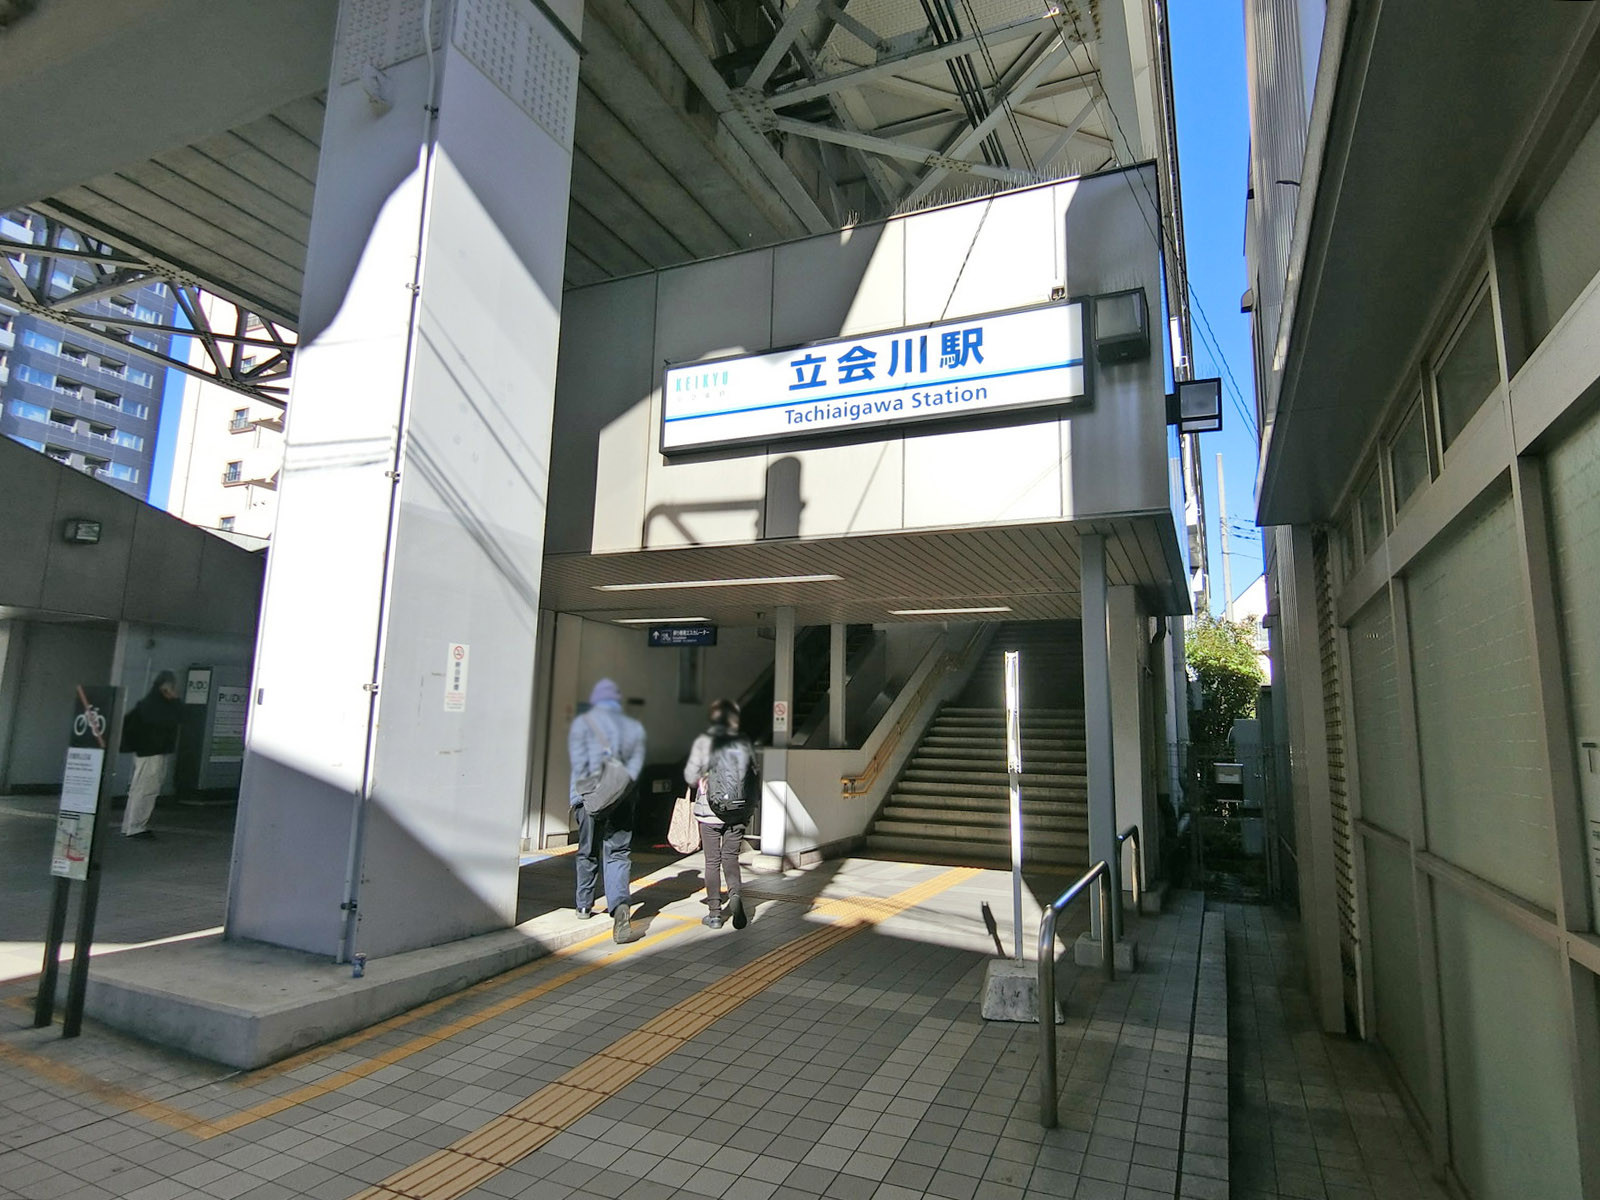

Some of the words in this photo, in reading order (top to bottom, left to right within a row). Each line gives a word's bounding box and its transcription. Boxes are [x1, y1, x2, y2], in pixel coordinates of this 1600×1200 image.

[788, 327, 985, 391] 立会川駅
[675, 370, 729, 393] KEIKYU
[784, 398, 904, 425] Tachiaigawa
[911, 386, 988, 409] Station
